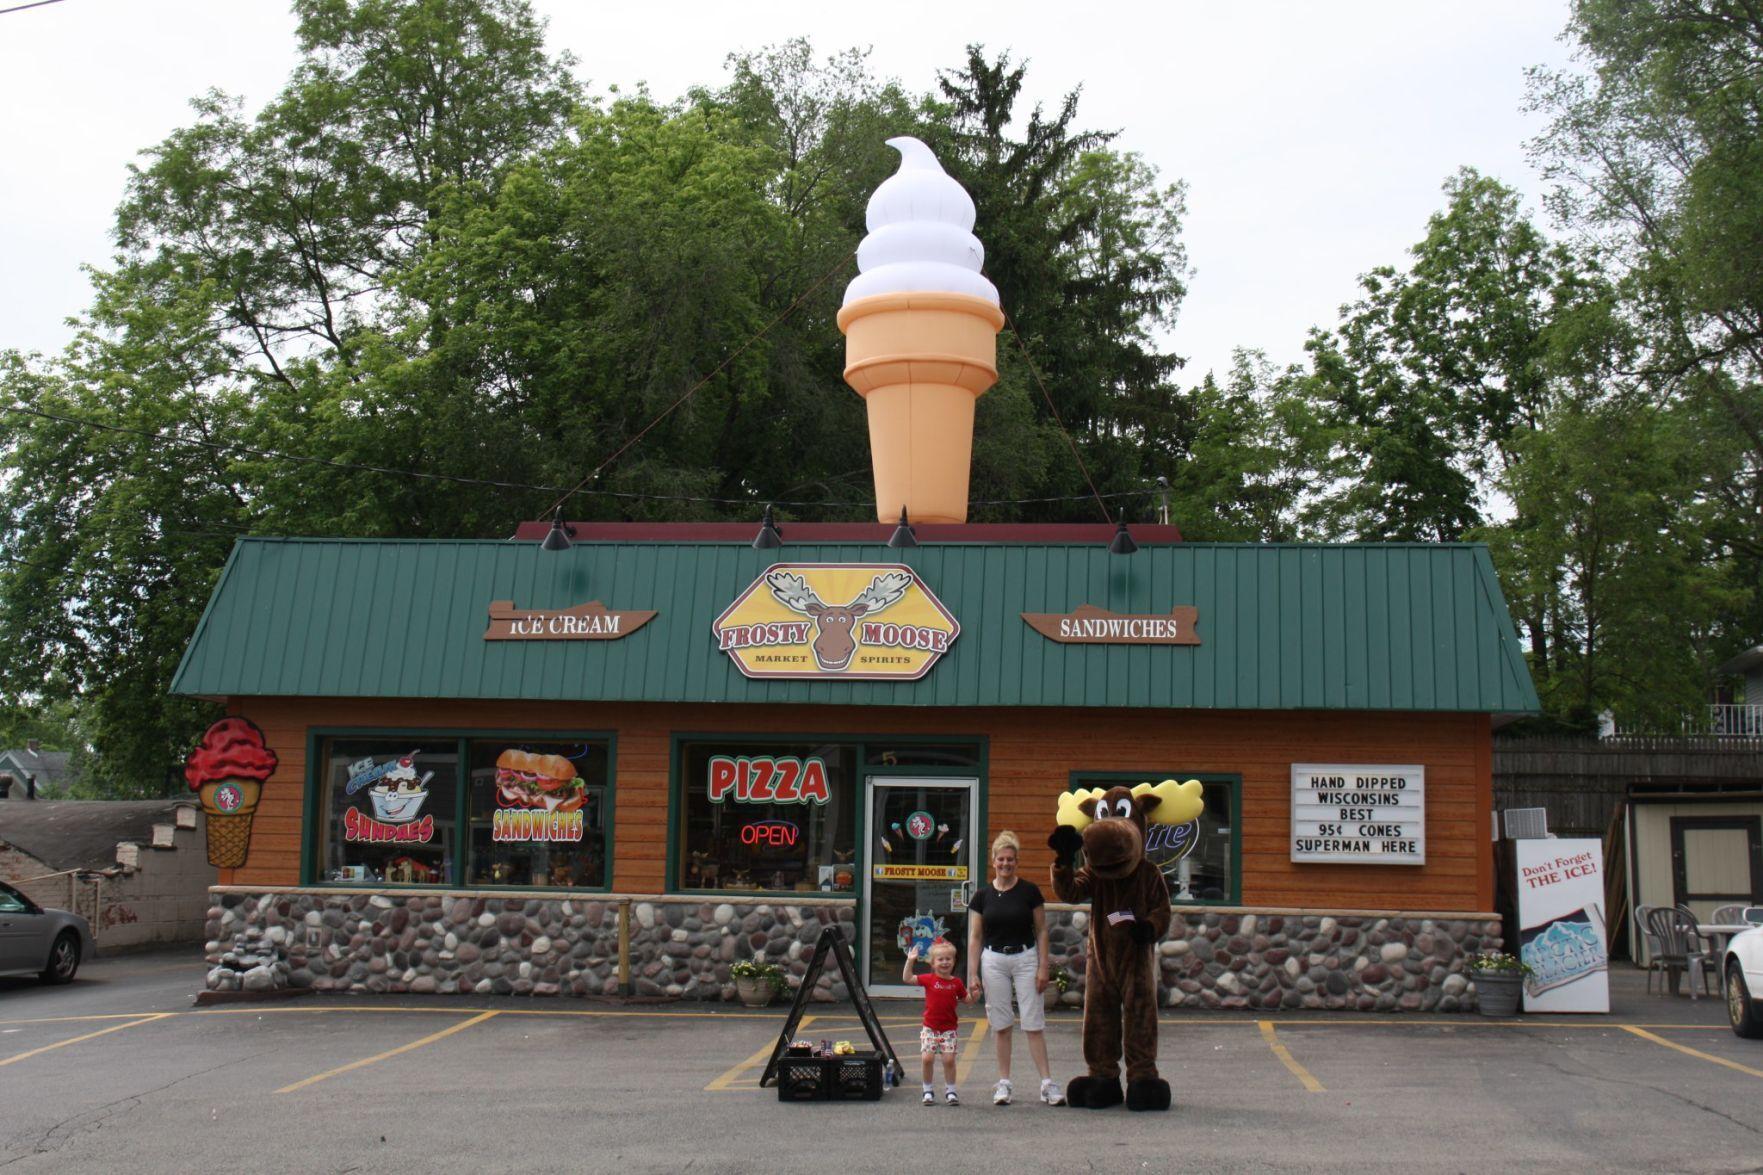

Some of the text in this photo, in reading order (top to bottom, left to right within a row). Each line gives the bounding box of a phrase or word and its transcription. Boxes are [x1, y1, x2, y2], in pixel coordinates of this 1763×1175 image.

[510, 615, 621, 635] ICE CREAM
[1060, 619, 1177, 638] SANDWICHES
[720, 622, 949, 652] FROSTY MOOSE
[755, 655, 911, 664] MARKET SPIRITS
[708, 756, 832, 804] PIZZA
[1311, 777, 1406, 789] HAND DIPPED
[1318, 792, 1399, 805] WISCONSINS
[1340, 808, 1373, 820] BEST
[345, 806, 434, 843] SUNDAES
[493, 808, 584, 842] SANDWICHES
[1319, 824, 1401, 837] 95¢ CONES
[741, 825, 796, 846] OPEN
[1296, 839, 1416, 853] SUPERMAN HERE
[884, 866, 916, 876] FROSTY
[918, 867, 947, 877] MOOSE
[1522, 851, 1593, 877] Don't Forget
[1526, 863, 1597, 889] THE ICE!
